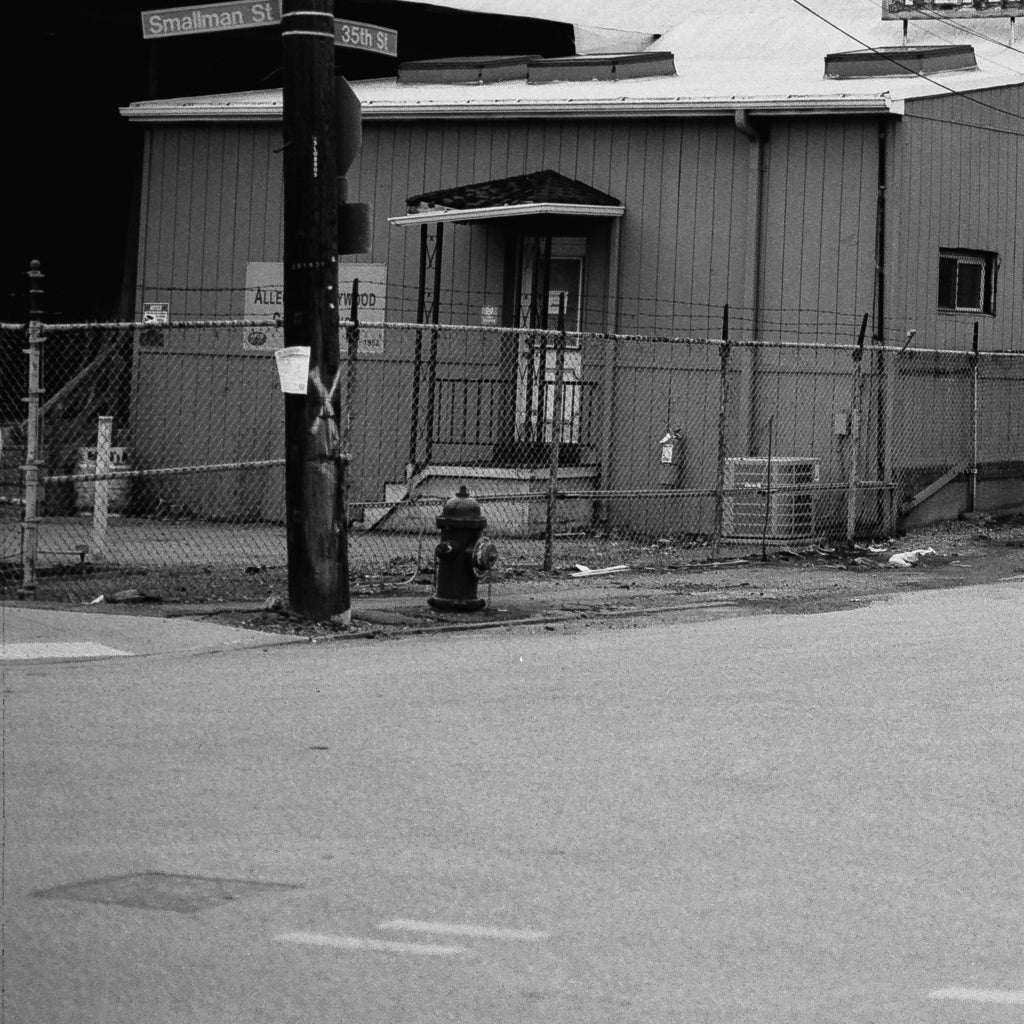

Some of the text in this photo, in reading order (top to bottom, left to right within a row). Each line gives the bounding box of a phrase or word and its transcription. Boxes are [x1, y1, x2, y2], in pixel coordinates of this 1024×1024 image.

[149, 2, 274, 34] Smallman St
[341, 24, 388, 51] 35th St
